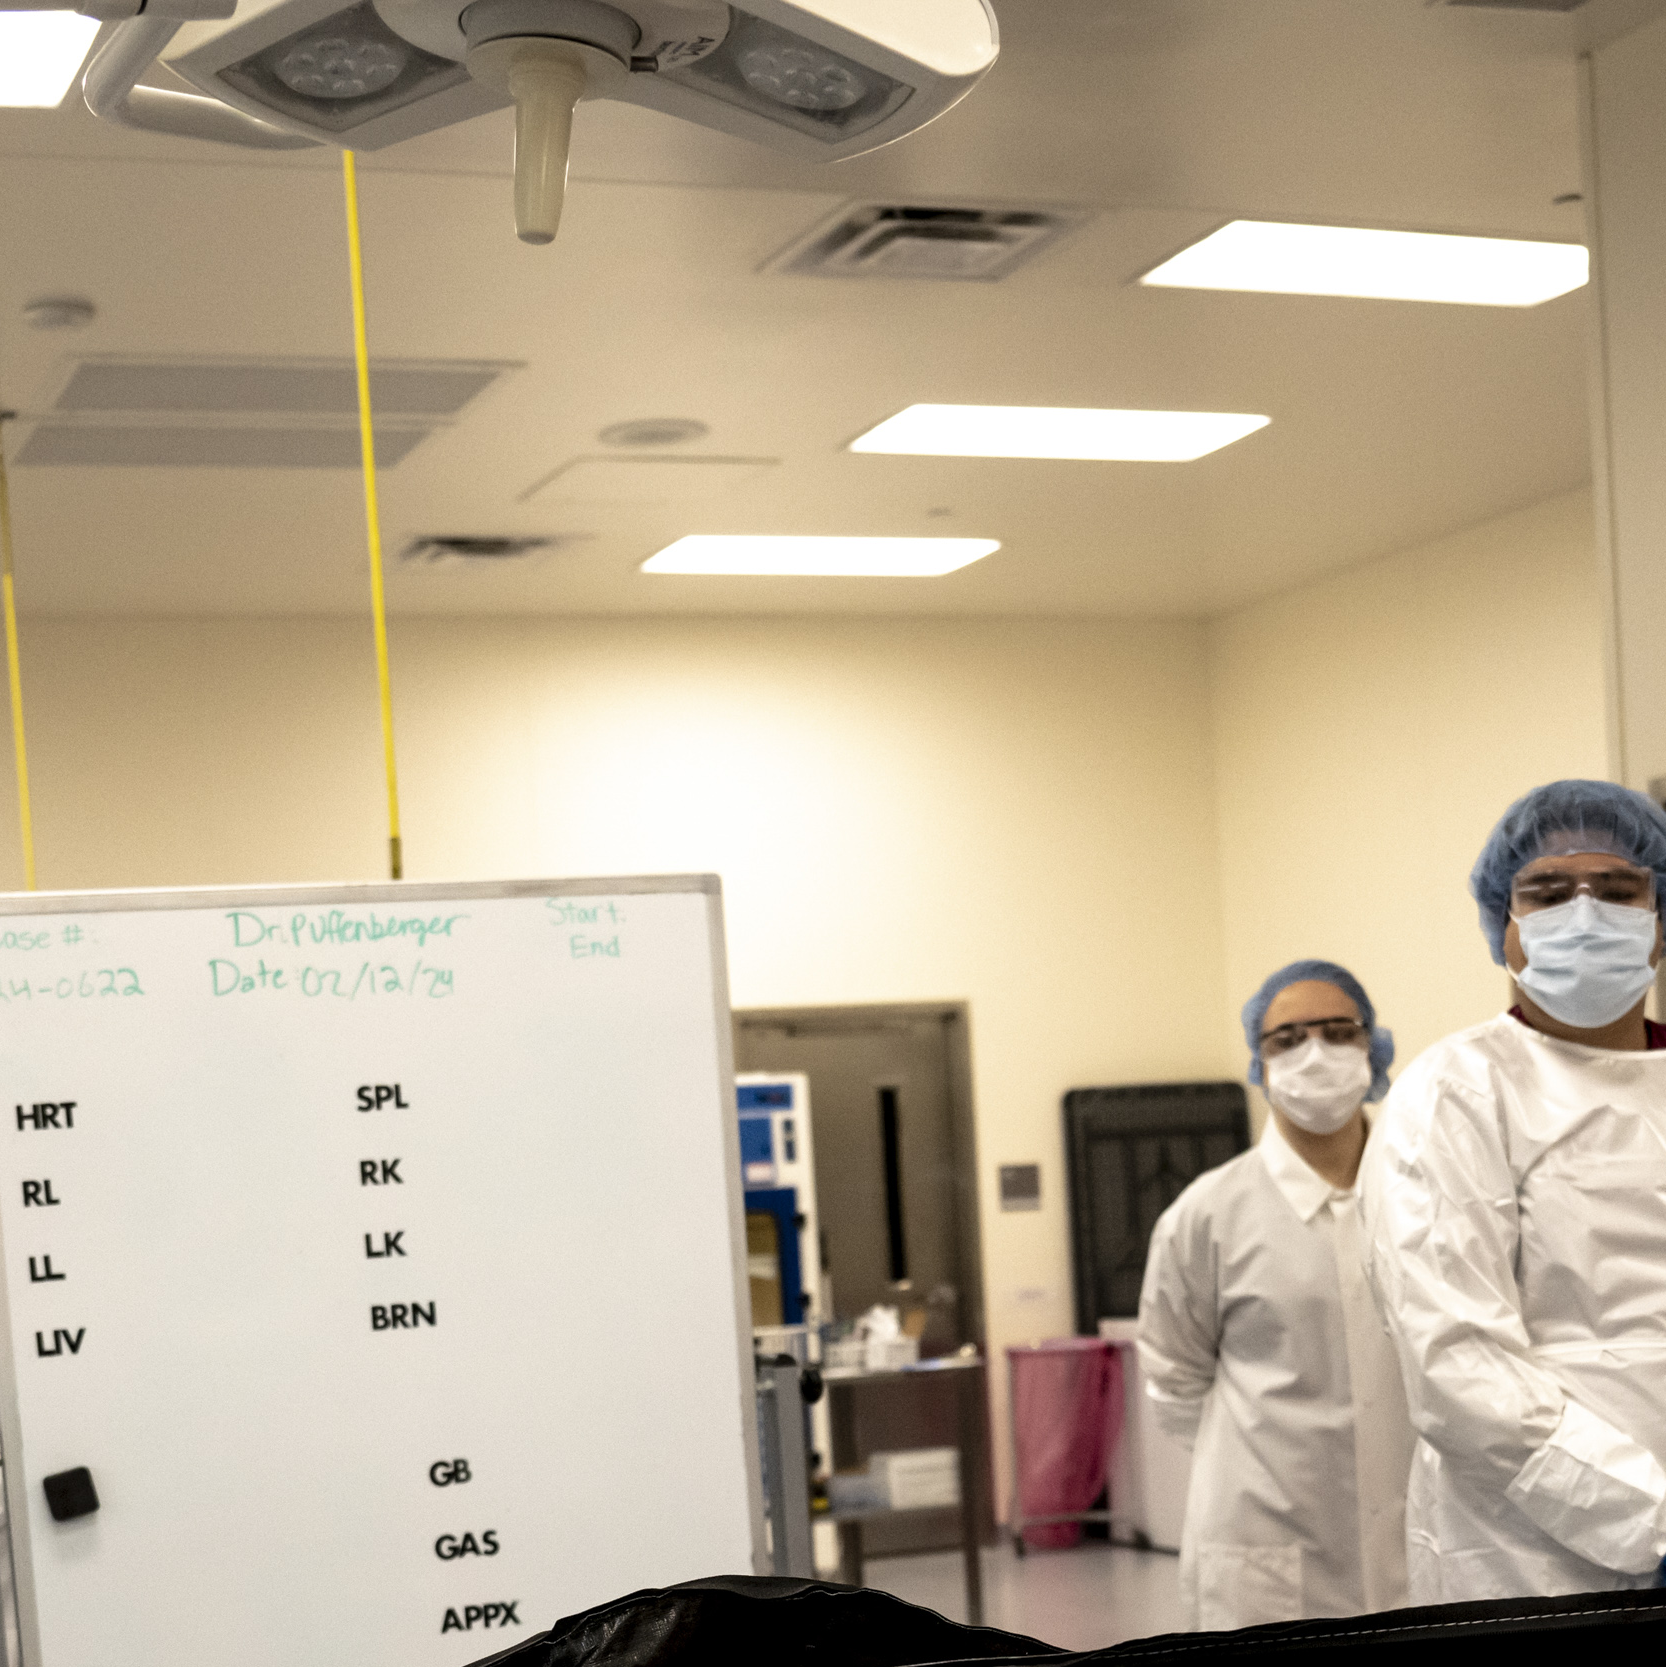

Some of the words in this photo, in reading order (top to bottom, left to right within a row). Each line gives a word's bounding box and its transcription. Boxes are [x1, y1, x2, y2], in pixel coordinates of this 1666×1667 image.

[570, 934, 620, 959] End
[356, 1084, 409, 1113] SPL
[15, 1101, 77, 1131] HRT
[359, 1158, 403, 1186] RK
[22, 1179, 60, 1208] RL
[364, 1231, 406, 1259] LK
[28, 1255, 66, 1283] LL
[370, 1301, 437, 1331] BRN
[35, 1327, 86, 1358] LIV
[429, 1458, 472, 1488] GB
[434, 1529, 500, 1561] GAS
[440, 1601, 521, 1635] APPX
